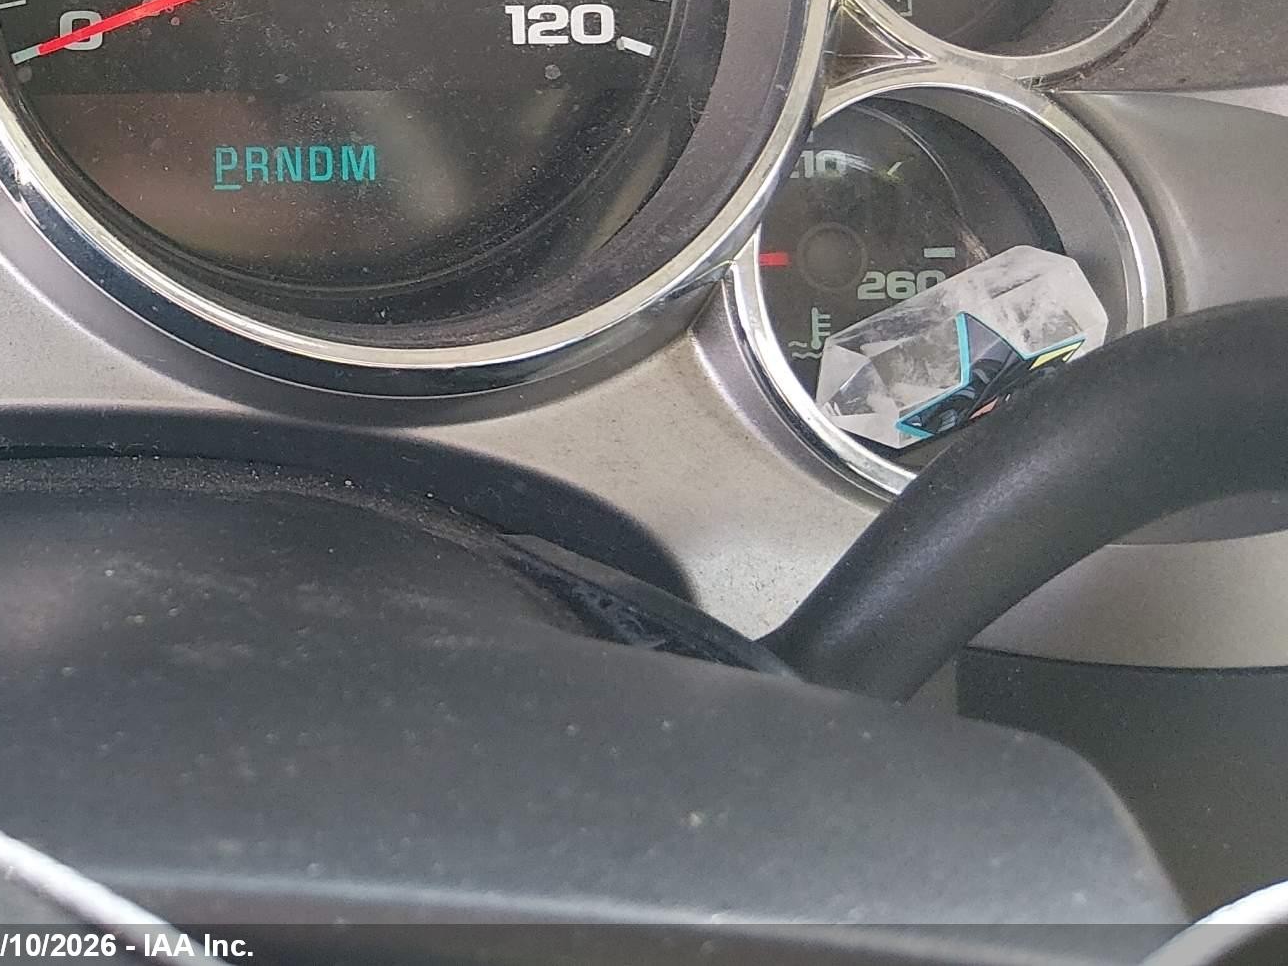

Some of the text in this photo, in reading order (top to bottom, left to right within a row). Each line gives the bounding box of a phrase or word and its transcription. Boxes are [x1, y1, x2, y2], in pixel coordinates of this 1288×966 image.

[59, 10, 103, 51] 0
[505, 4, 616, 45] 120
[214, 144, 376, 184] PRNDM
